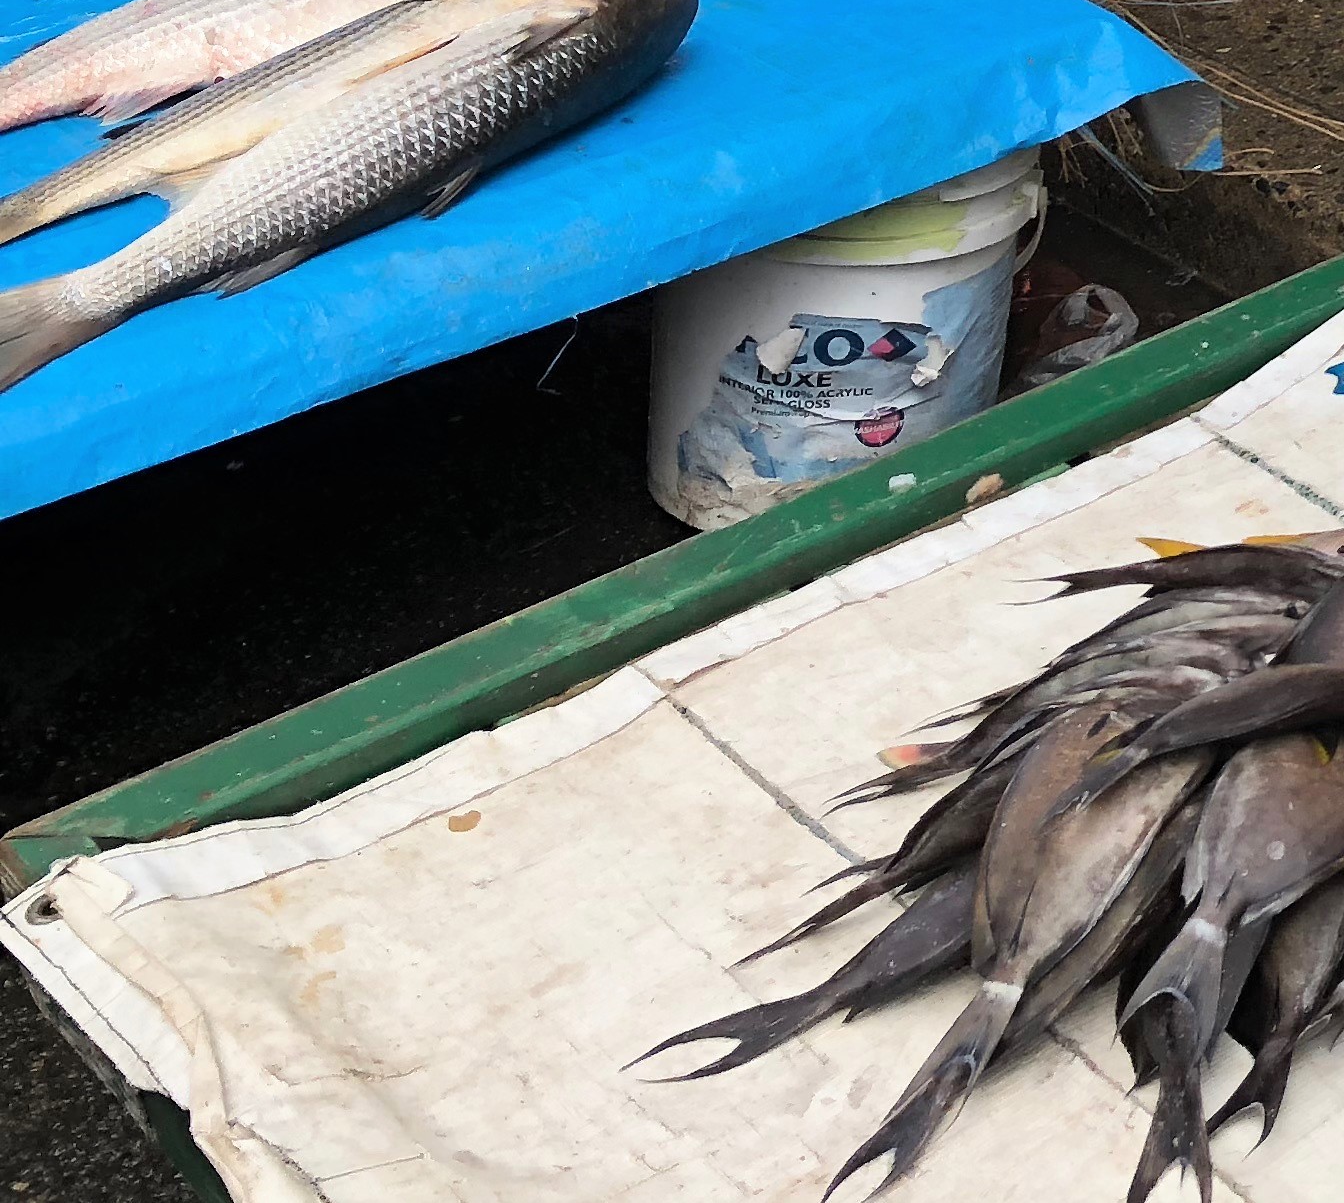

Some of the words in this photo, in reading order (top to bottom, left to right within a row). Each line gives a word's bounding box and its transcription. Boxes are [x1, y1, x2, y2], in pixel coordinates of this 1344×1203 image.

[756, 364, 832, 388] LUXE
[780, 389, 813, 399] 100%
[816, 387, 874, 399] ACRYLIC
